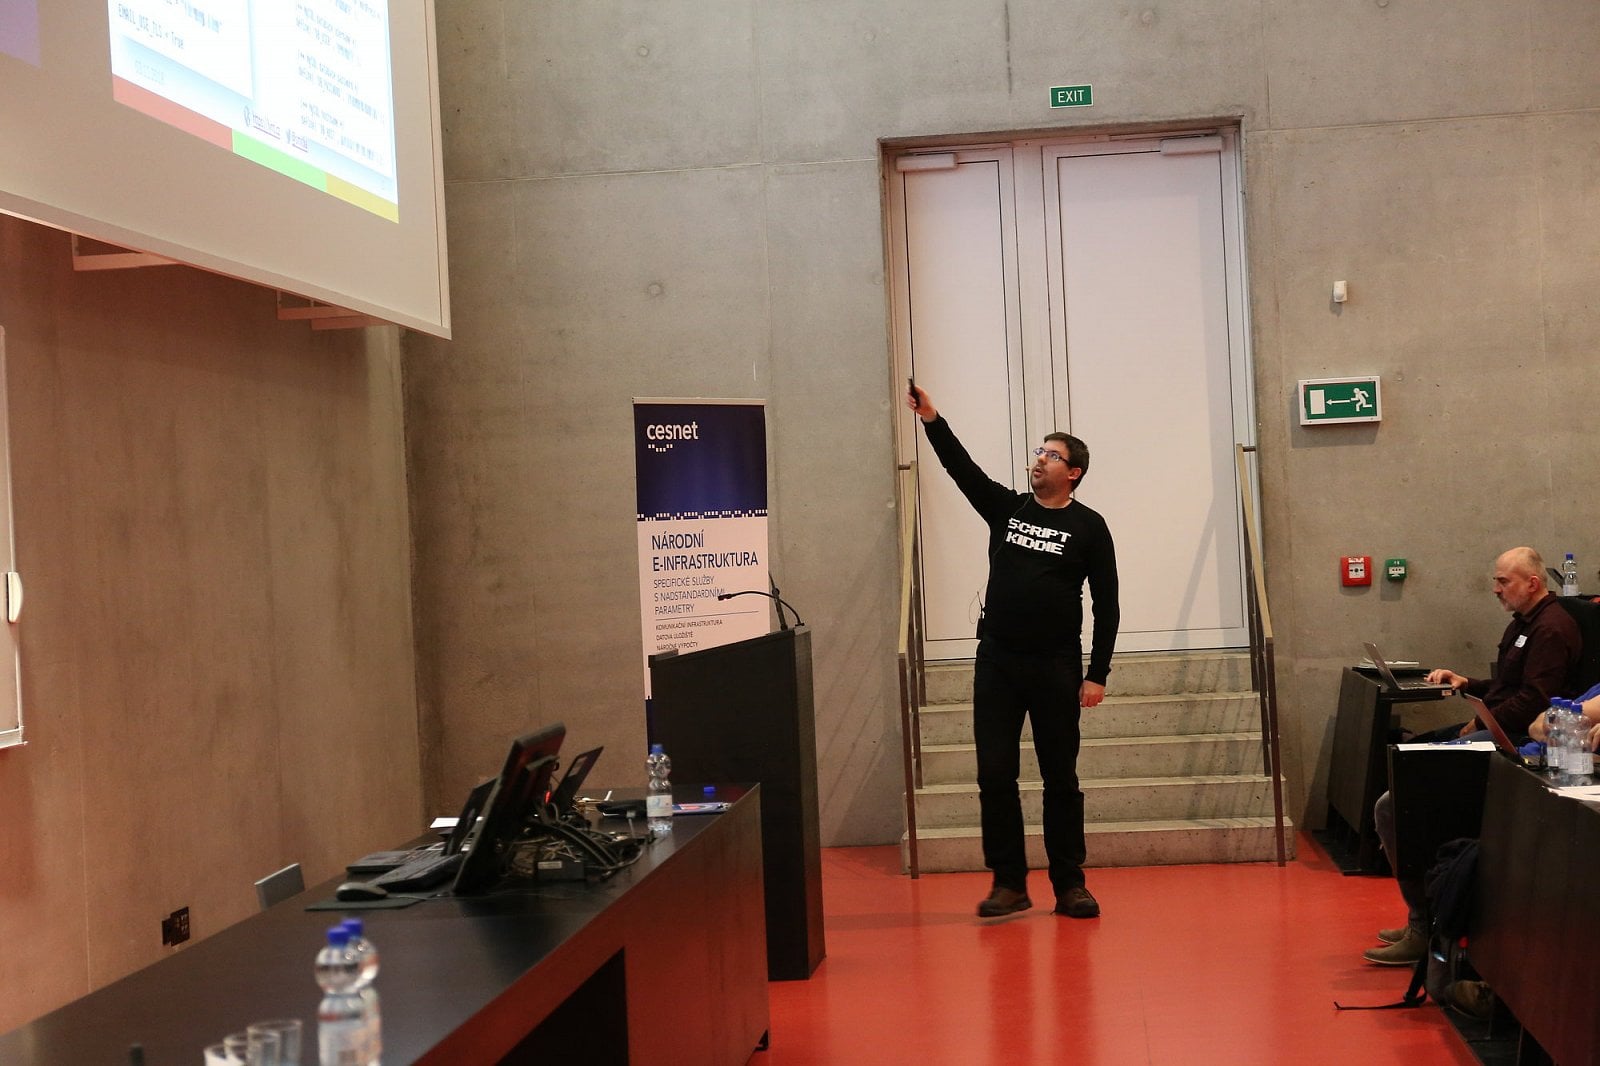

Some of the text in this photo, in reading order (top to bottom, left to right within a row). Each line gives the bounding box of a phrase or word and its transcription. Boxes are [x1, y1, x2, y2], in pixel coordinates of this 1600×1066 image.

[1057, 89, 1085, 103] EXIT
[646, 421, 699, 440] cesnet
[651, 529, 704, 550] NÁRODNÍ
[1007, 517, 1072, 543] SCRIPT
[1005, 531, 1065, 556] KIDDIE
[652, 551, 759, 572] E-INFRASTRUKTURA
[692, 574, 715, 586] SLUŽBY
[654, 592, 659, 602] S
[654, 604, 695, 615] PARAMETRY
